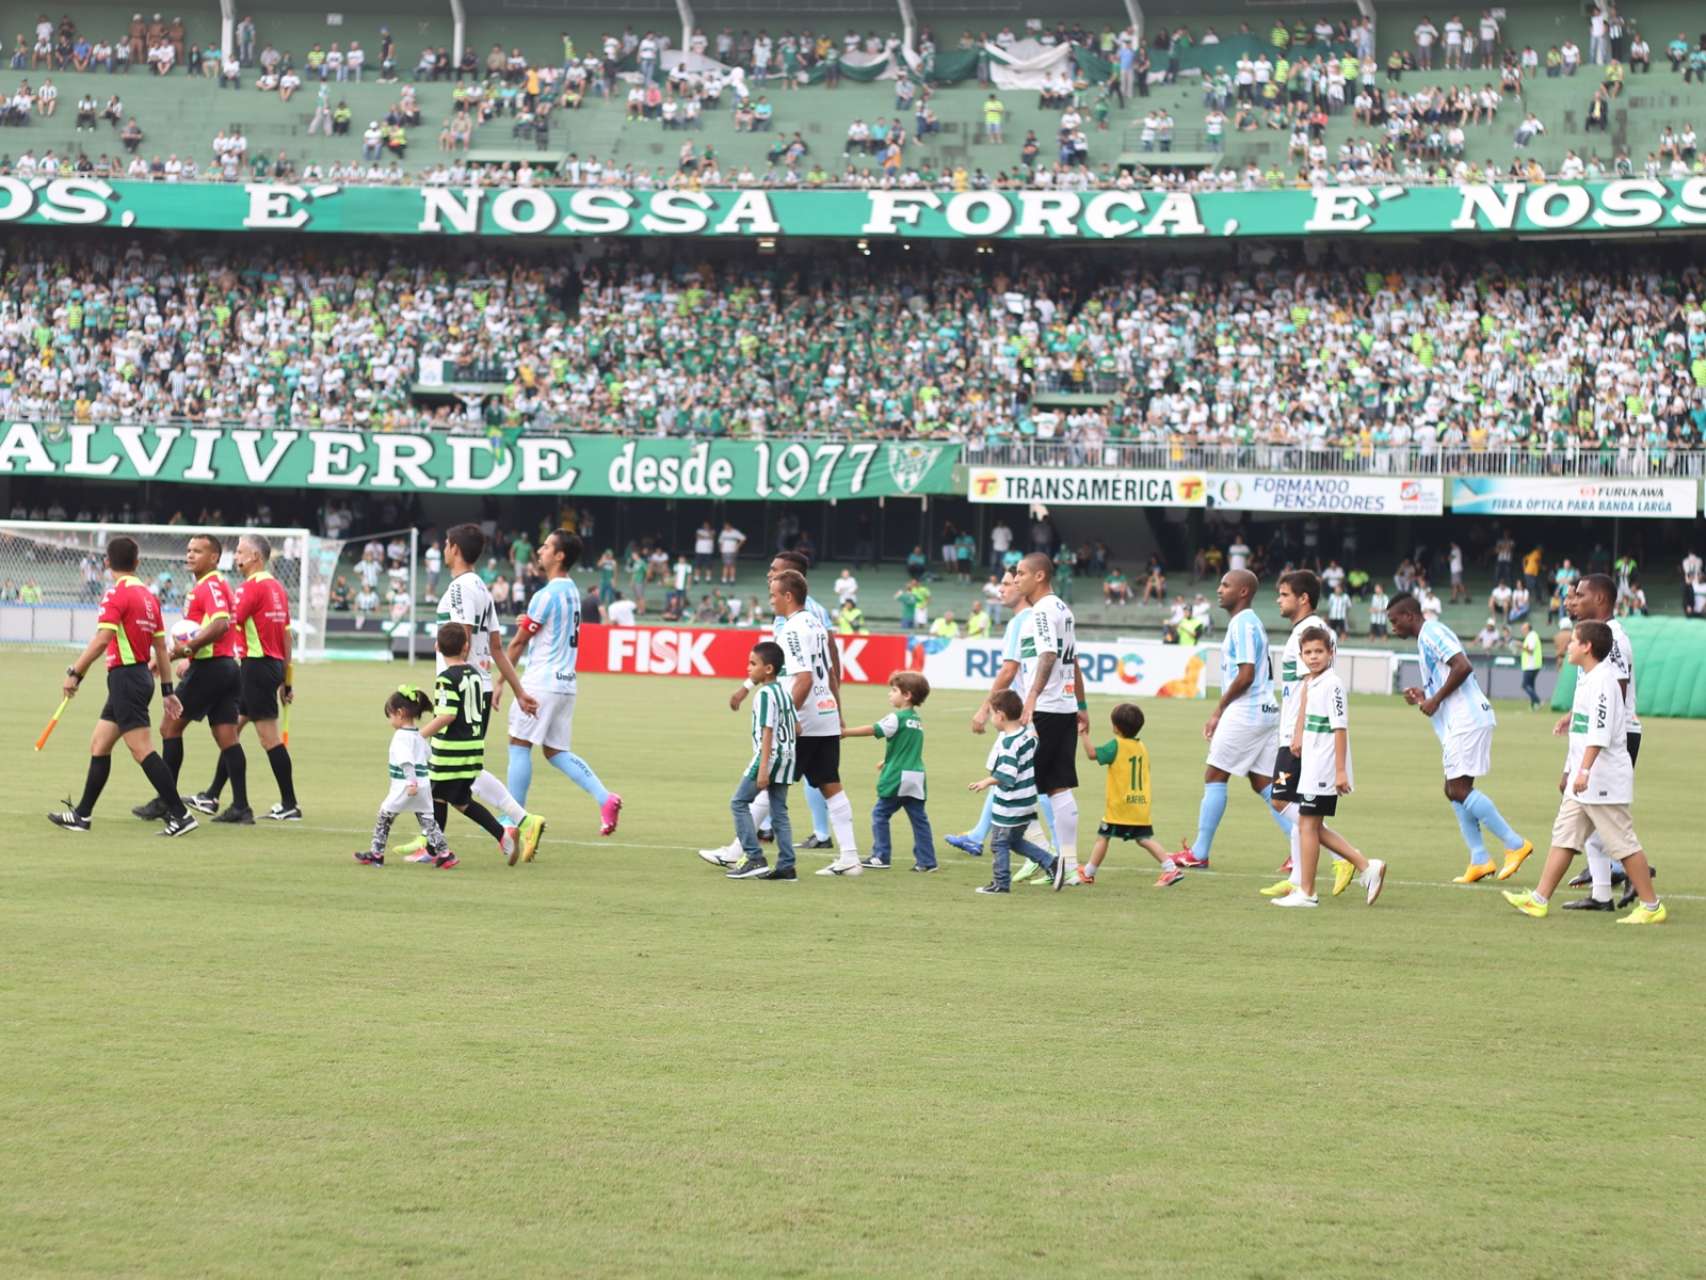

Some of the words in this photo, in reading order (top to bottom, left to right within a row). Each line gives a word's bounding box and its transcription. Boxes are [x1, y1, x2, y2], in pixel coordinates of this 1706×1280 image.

[418, 186, 780, 235] NOSSA
[0, 422, 577, 493] ALVIVERDE
[609, 442, 734, 496] desde
[755, 443, 878, 494] 1977
[1005, 475, 1174, 502] TRANSAMÉRICA
[1254, 477, 1350, 495] FORMANDO
[1598, 487, 1665, 498] FURUKAWA
[1273, 494, 1385, 512] PENSADORES
[1492, 499, 1524, 511] FIBRA
[1567, 500, 1596, 513] PARA
[1598, 502, 1635, 514] BANDA
[1638, 502, 1673, 514] LARGA
[607, 629, 716, 675] FISK
[458, 673, 484, 724] 10
[1128, 755, 1143, 791] 11
